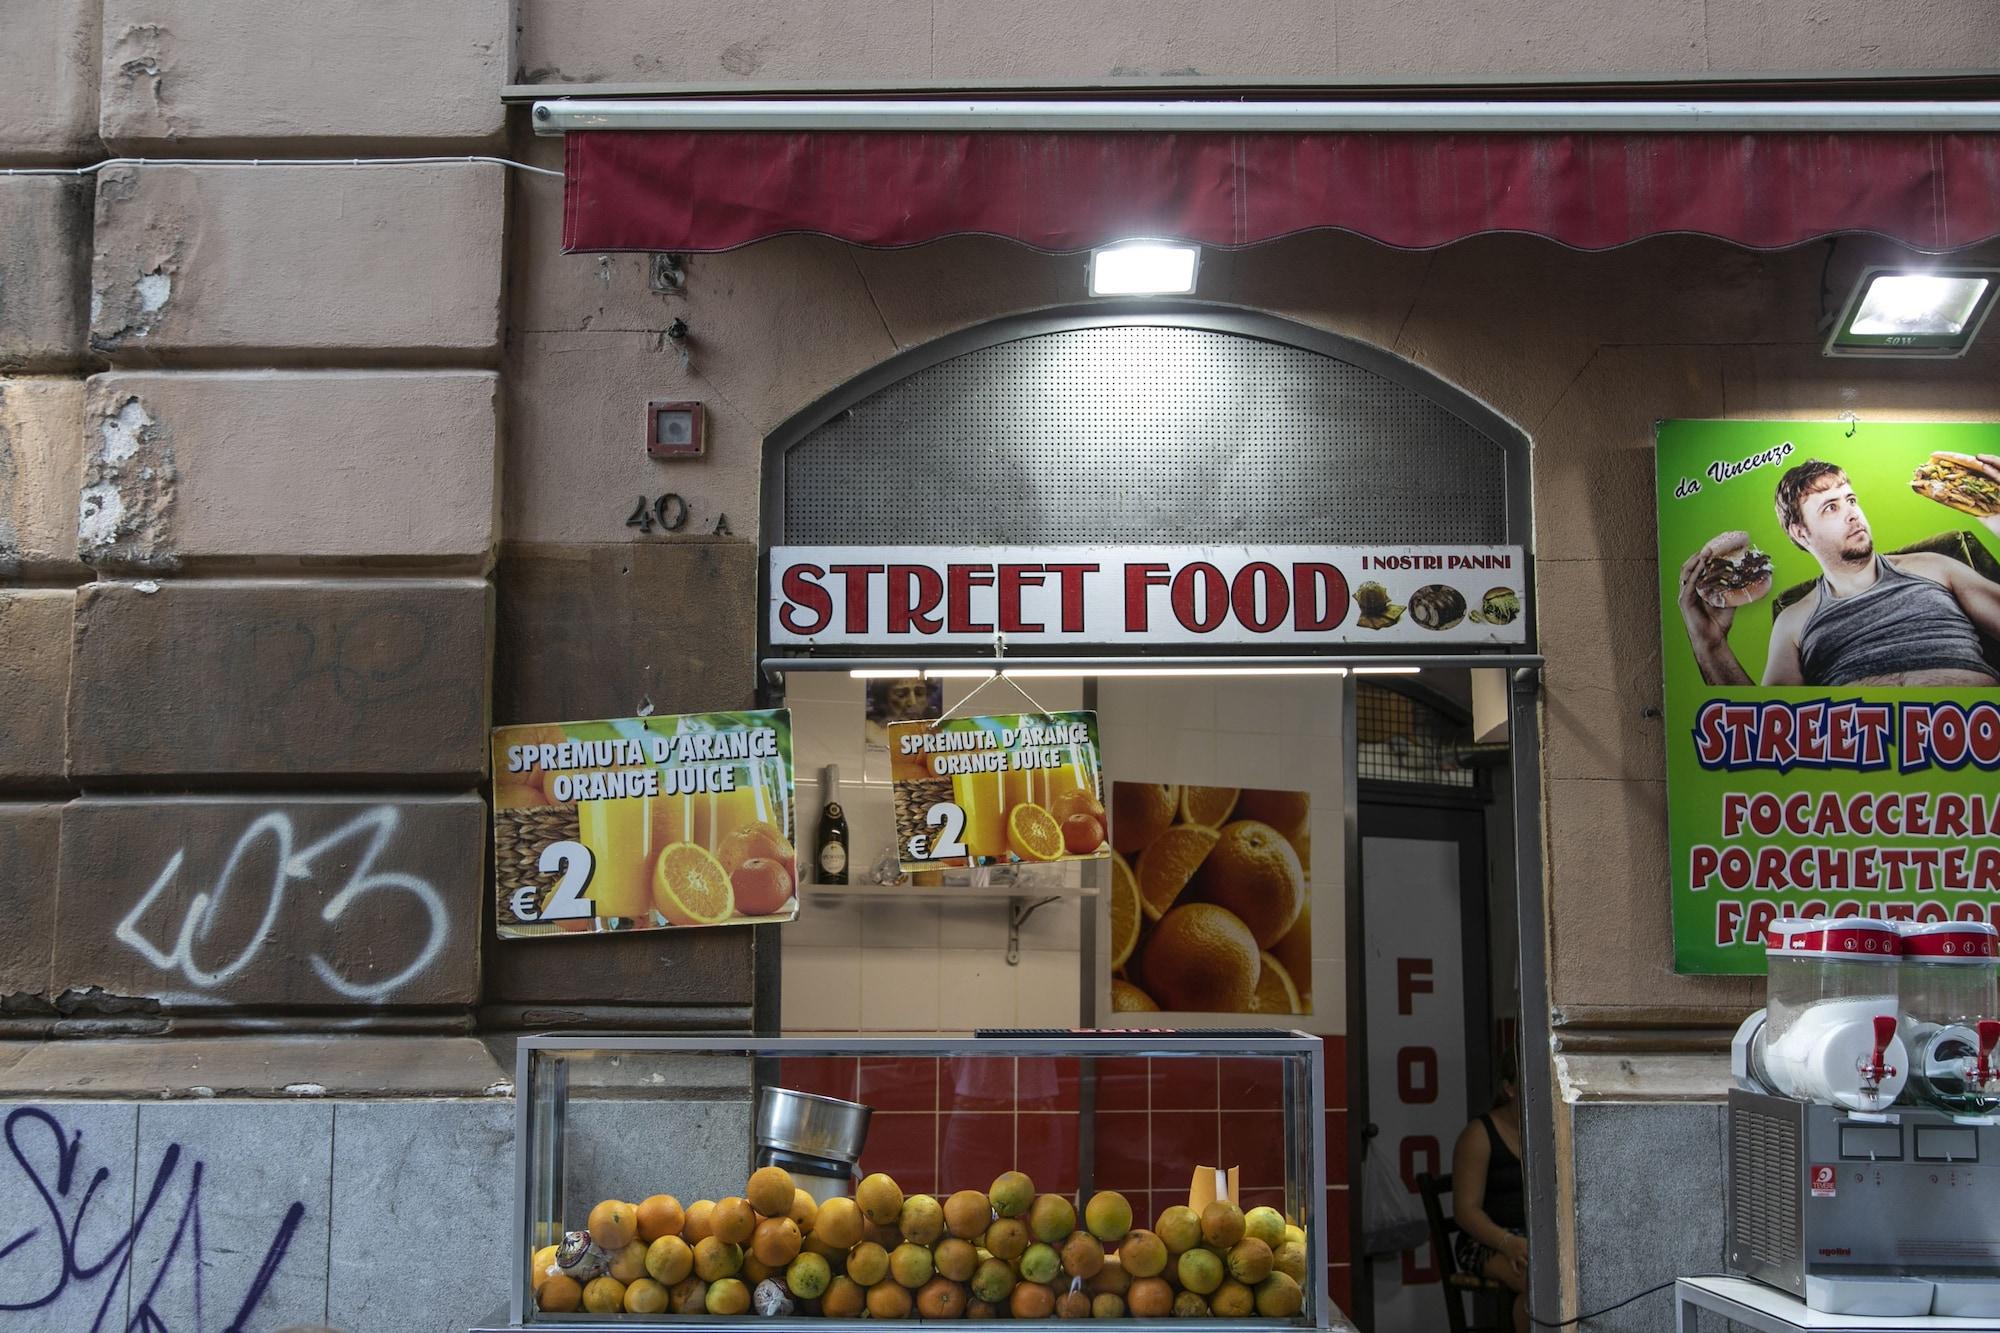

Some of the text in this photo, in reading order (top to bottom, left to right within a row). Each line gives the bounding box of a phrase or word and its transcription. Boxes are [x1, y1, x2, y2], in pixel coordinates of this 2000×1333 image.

[1673, 441, 1796, 500] da Vincenzo
[625, 492, 733, 536] 40 A
[1362, 555, 1511, 570] I NOSTRI PANINI
[779, 562, 1350, 634] STREET FOOD
[508, 730, 778, 773] SPREMUTA D'ARANCE
[901, 724, 1090, 755] SPREMUTA D'ARANCE
[1694, 700, 2000, 769] STREET FOO
[934, 748, 1061, 775] ORANGE JUICE
[554, 765, 736, 802] ORANGE JUICE
[1819, 1248, 1851, 1256] ugolini
